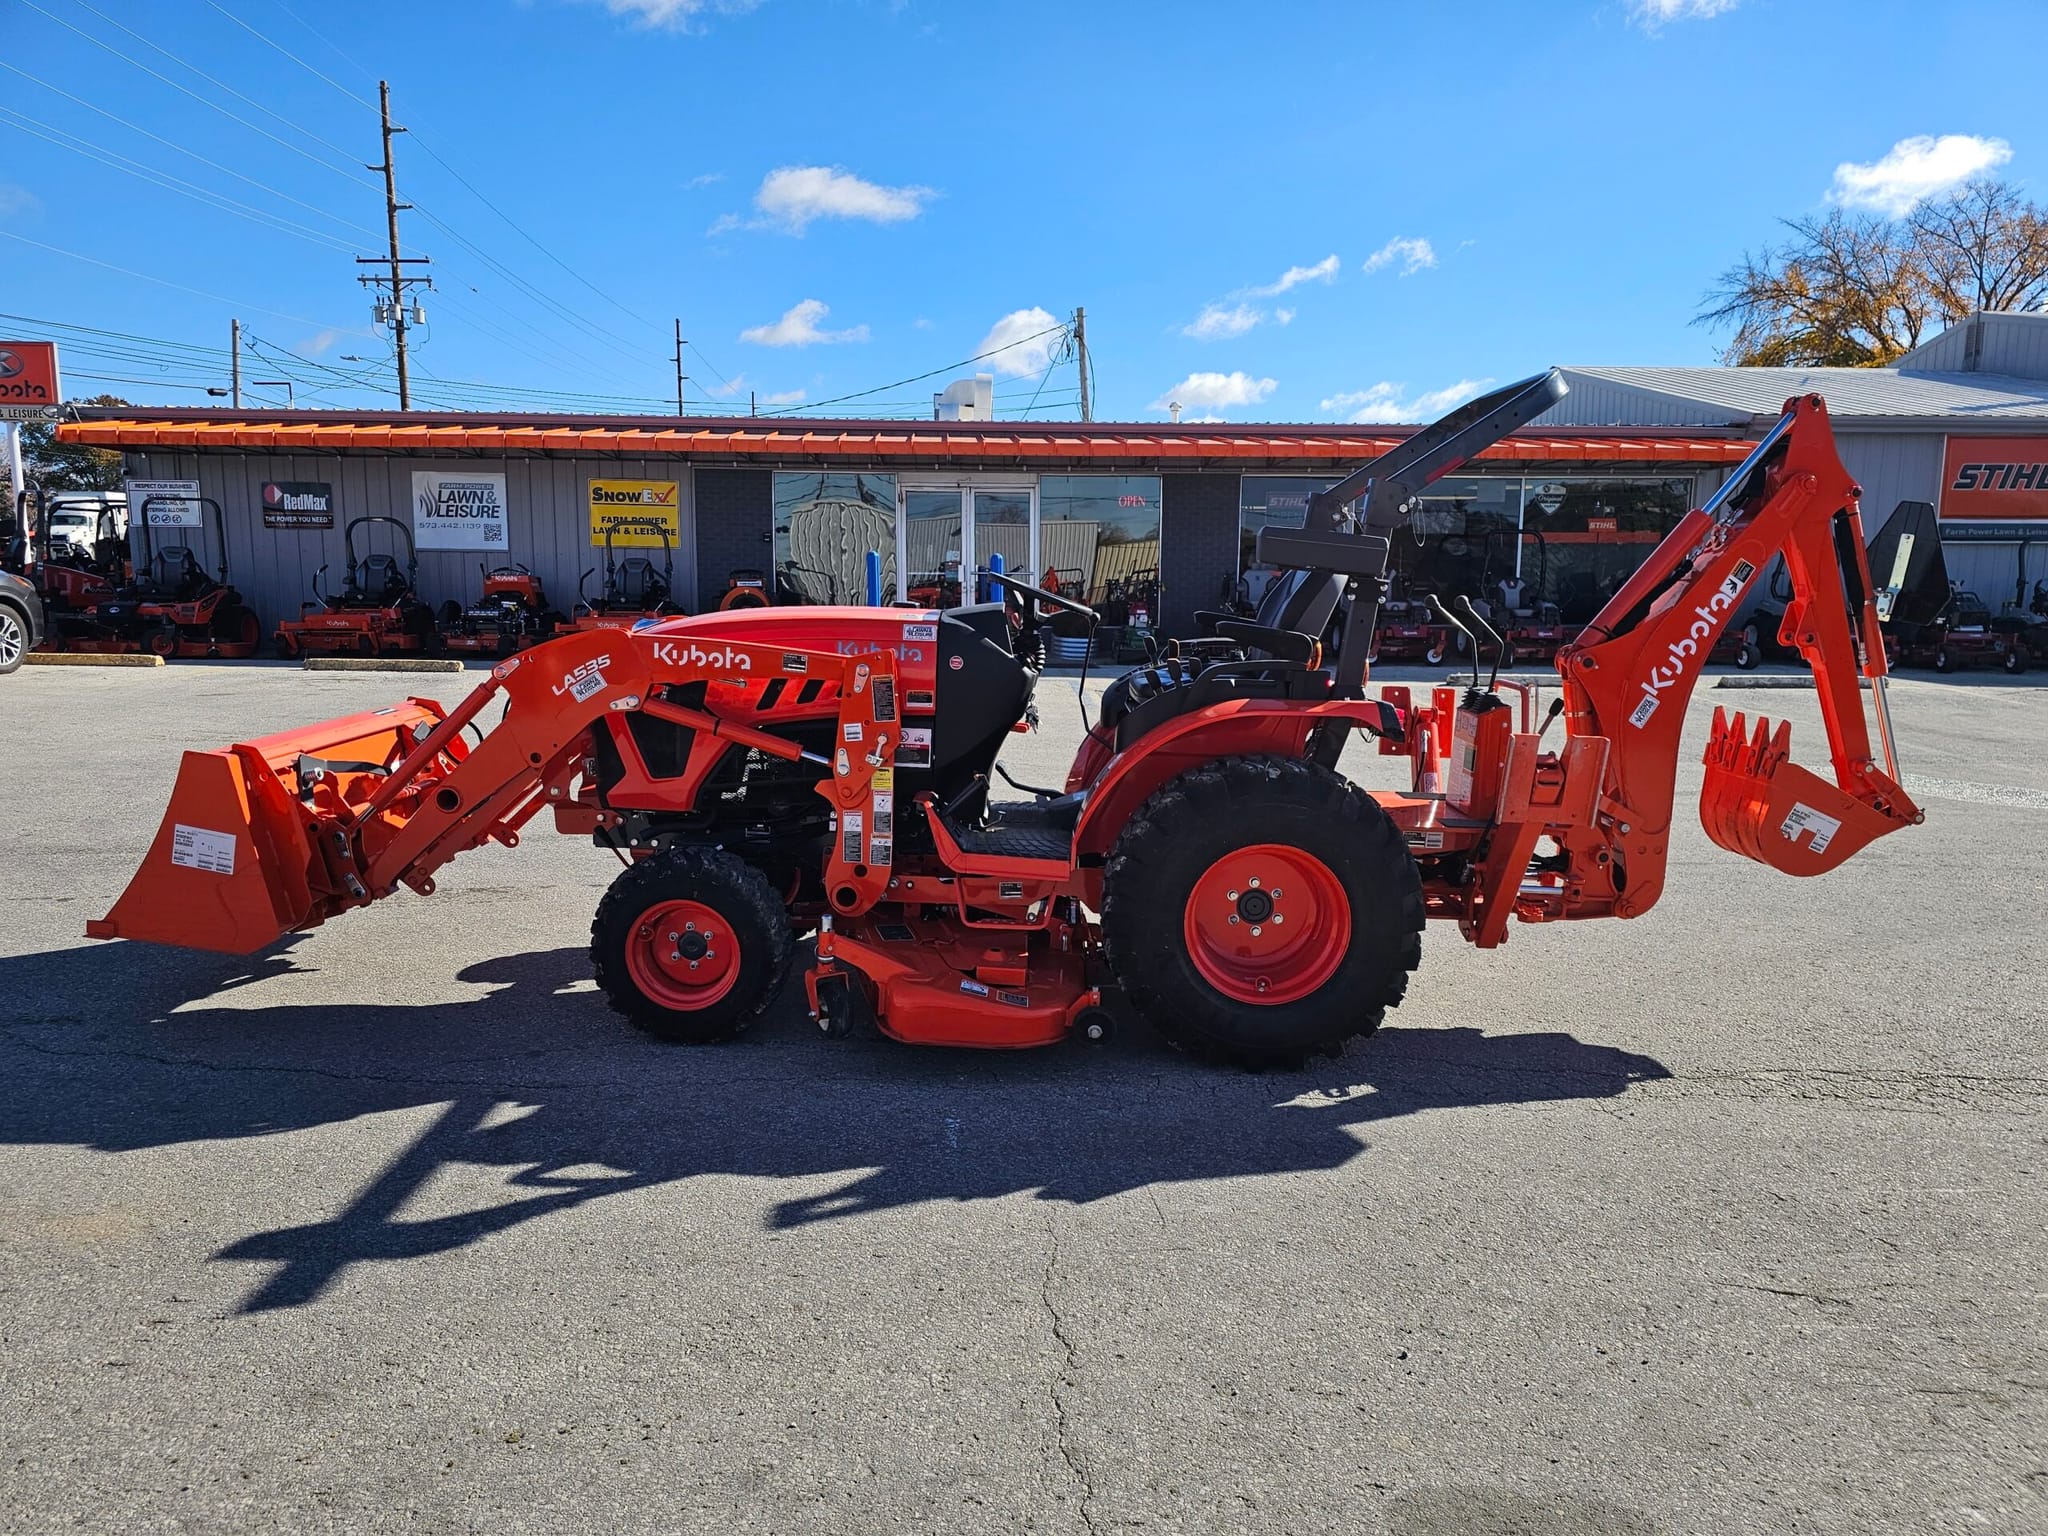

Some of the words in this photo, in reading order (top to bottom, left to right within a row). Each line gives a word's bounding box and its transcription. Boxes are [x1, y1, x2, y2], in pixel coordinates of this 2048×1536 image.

[1951, 462, 2048, 491] STIHL
[283, 493, 328, 511] RedMax
[438, 489, 485, 505] LAWN
[485, 490, 497, 505] &
[1118, 495, 1146, 508] OPEN
[265, 515, 276, 523] THE
[276, 515, 298, 523] POWER
[436, 504, 501, 519] LEISURE
[419, 522, 481, 530] 573.442.1139
[623, 527, 631, 535] &
[1588, 521, 1616, 529] STIHL
[1945, 528, 1966, 536] Farm
[1968, 528, 1994, 536] Power
[1994, 528, 2016, 536] Lawn
[837, 639, 923, 662] Kubta
[1640, 593, 1734, 696] Kubota
[654, 643, 751, 670] Kubota
[552, 654, 611, 696] LA535
